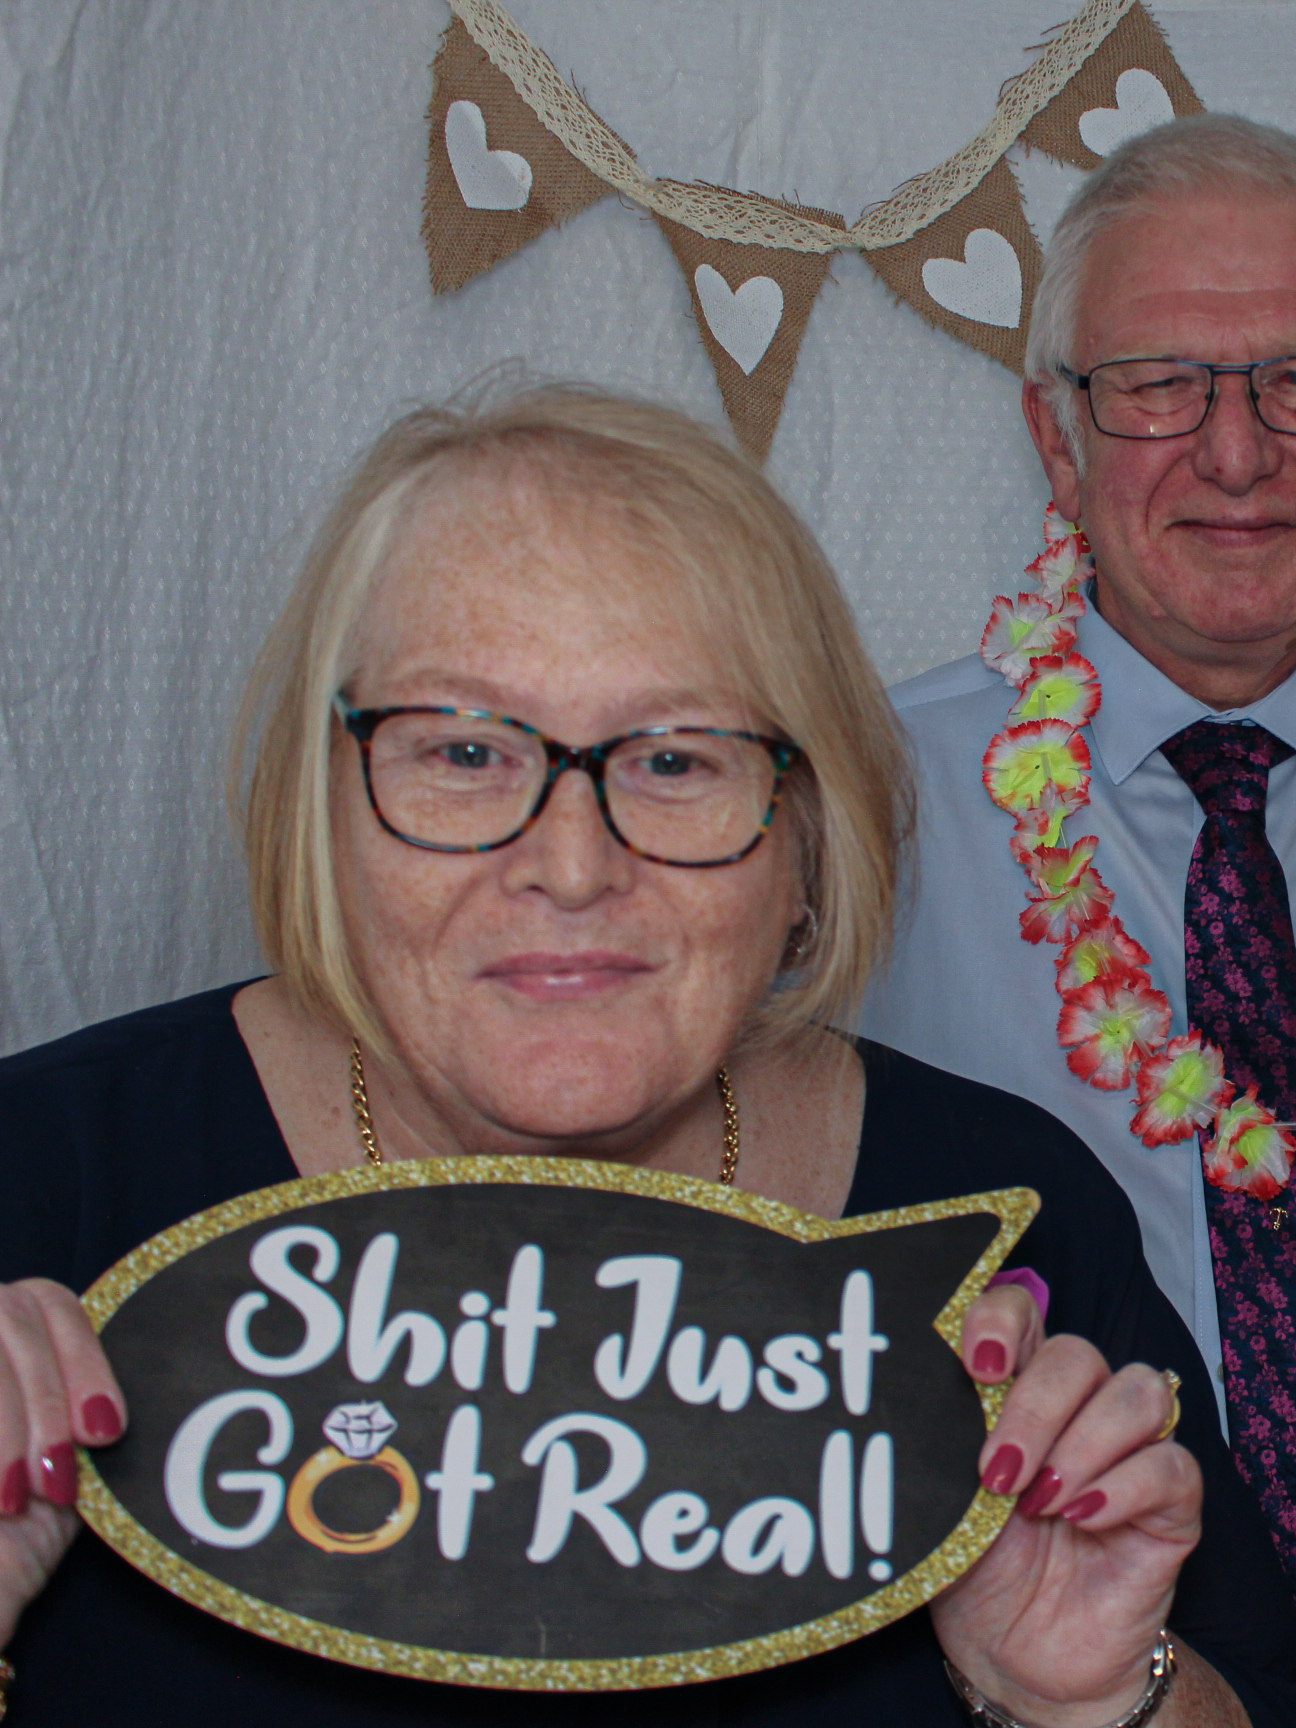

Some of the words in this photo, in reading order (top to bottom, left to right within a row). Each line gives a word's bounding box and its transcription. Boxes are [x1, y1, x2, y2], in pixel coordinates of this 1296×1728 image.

[225, 1225, 556, 1394] Shit
[594, 1254, 888, 1415] Just
[521, 1412, 893, 1582] Real!
